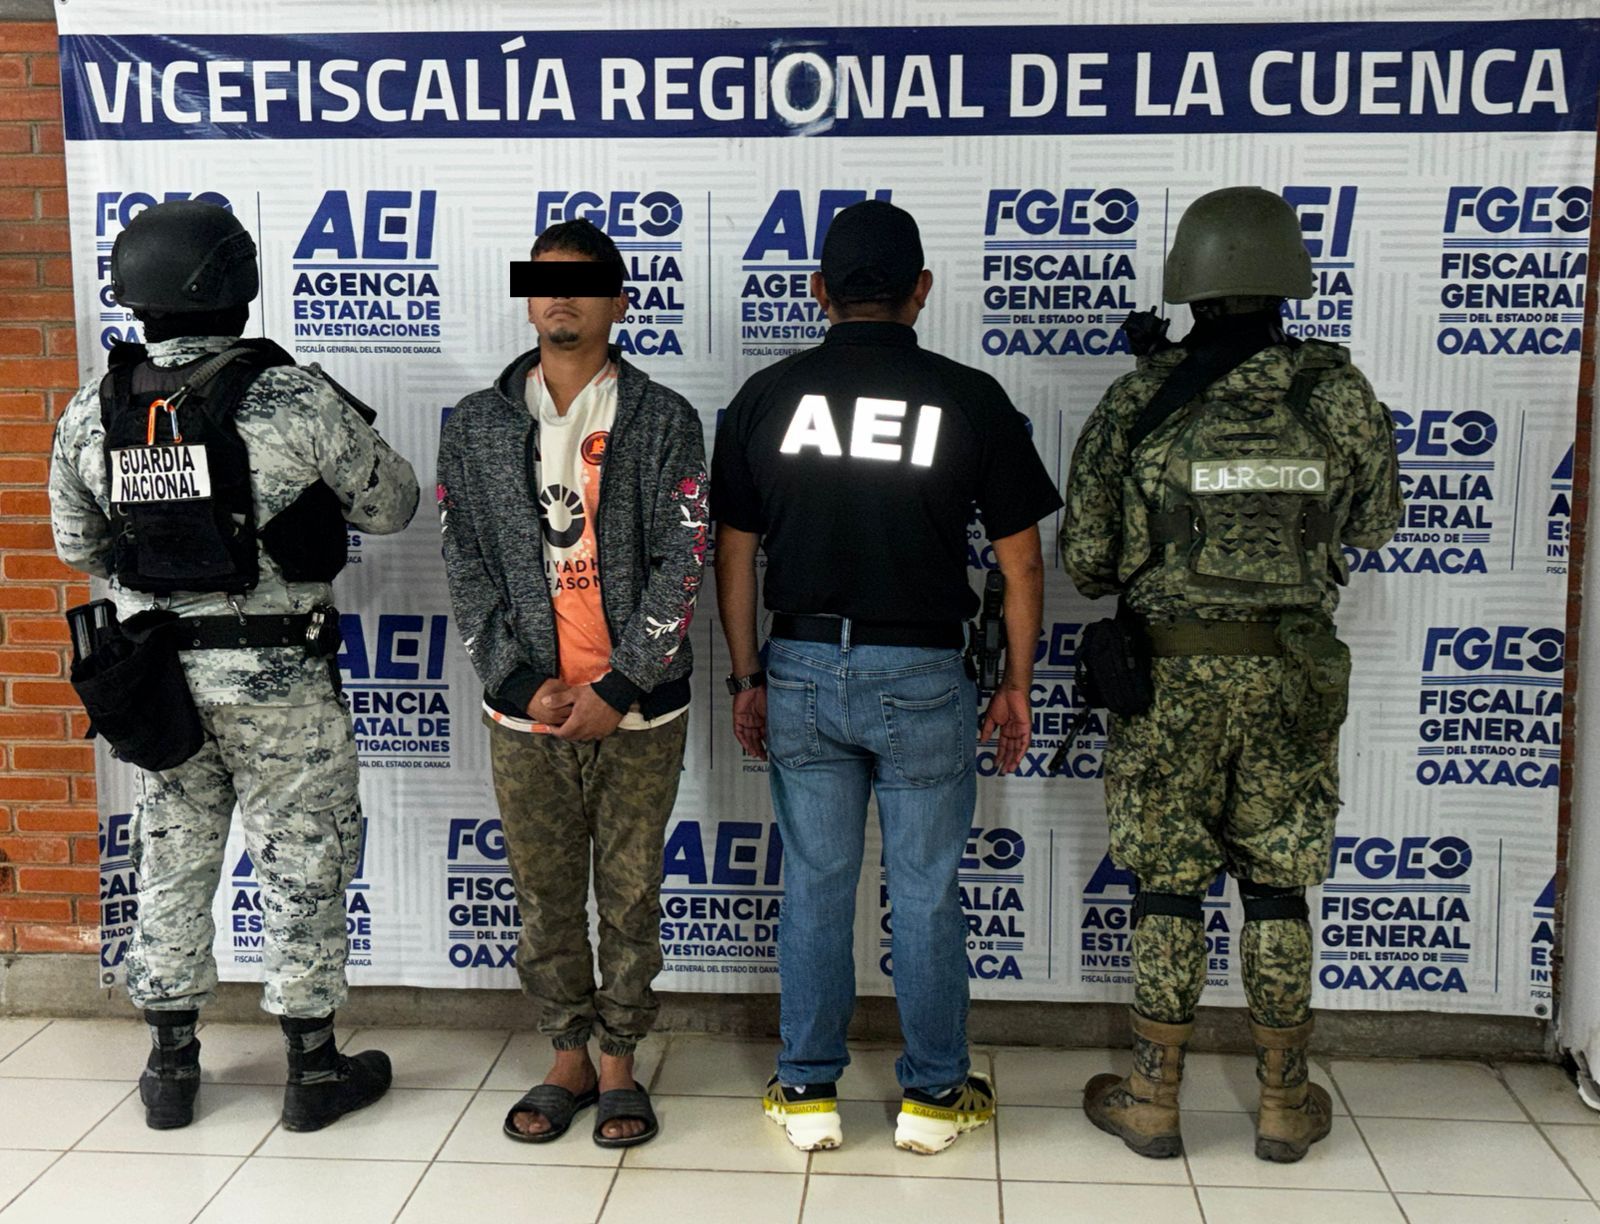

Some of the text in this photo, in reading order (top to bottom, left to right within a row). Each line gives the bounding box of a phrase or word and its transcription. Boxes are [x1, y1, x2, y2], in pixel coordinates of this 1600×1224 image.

[85, 36, 1569, 124] VICEFISCALÍA REGIONAL DE LA CUENCA
[984, 188, 1139, 236] FGEO
[1443, 186, 1592, 233] FGEO
[293, 190, 437, 260] AEI
[984, 253, 1136, 281] FISCALÍA
[293, 272, 440, 296] AGENCIA
[984, 285, 1137, 310] GENERAL
[294, 300, 440, 320] ESTATAL DE
[638, 315, 653, 324] DE
[1013, 314, 1103, 324] DEL ESTADO DE
[1317, 300, 1352, 320] DE
[1469, 313, 1559, 323] DEL ESTADO DE
[295, 323, 440, 337] INVESTIGACIONES
[296, 344, 325, 353] FISCALÍA
[326, 345, 359, 353] GENERAL
[360, 345, 373, 353] DEL
[413, 346, 441, 354] OAXACA
[779, 394, 942, 467] AEI
[120, 446, 195, 474] GUARDIA
[121, 472, 201, 501] NACIONAL
[1195, 465, 1321, 489] EJERCITO
[1393, 533, 1459, 543] ESTADO DE
[336, 614, 448, 680] AEI
[1422, 626, 1565, 672] FGEO
[418, 718, 450, 737] DE
[1077, 740, 1091, 748] DE
[1446, 745, 1536, 757] DEL ESTADO DE
[385, 760, 412, 768] ESTADO
[661, 820, 784, 885] AEI
[1321, 896, 1470, 922] FISCALÍA
[477, 931, 497, 940] DEL
[660, 922, 748, 941] STATAL
[1321, 924, 1471, 949] GENERAL
[979, 941, 994, 950] DE
[1350, 952, 1437, 961] DEL ESTADO DE
[1319, 964, 1468, 993] OAXACA
